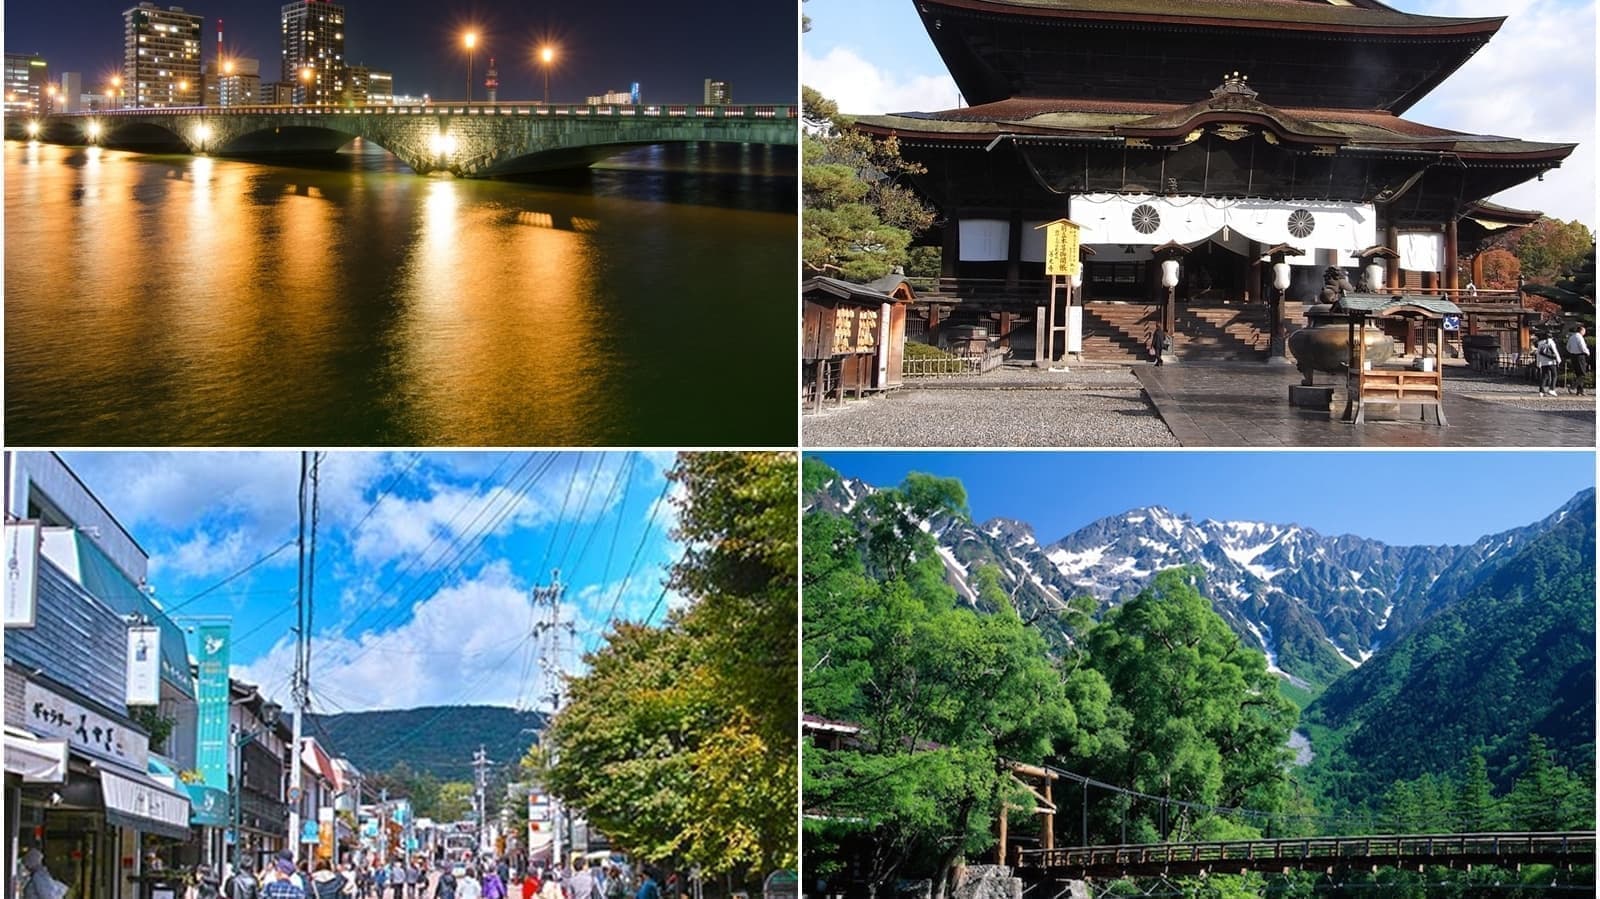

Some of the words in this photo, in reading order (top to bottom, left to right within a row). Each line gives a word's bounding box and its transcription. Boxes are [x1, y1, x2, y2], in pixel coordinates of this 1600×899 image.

[33, 702, 72, 727] ギャラリー
